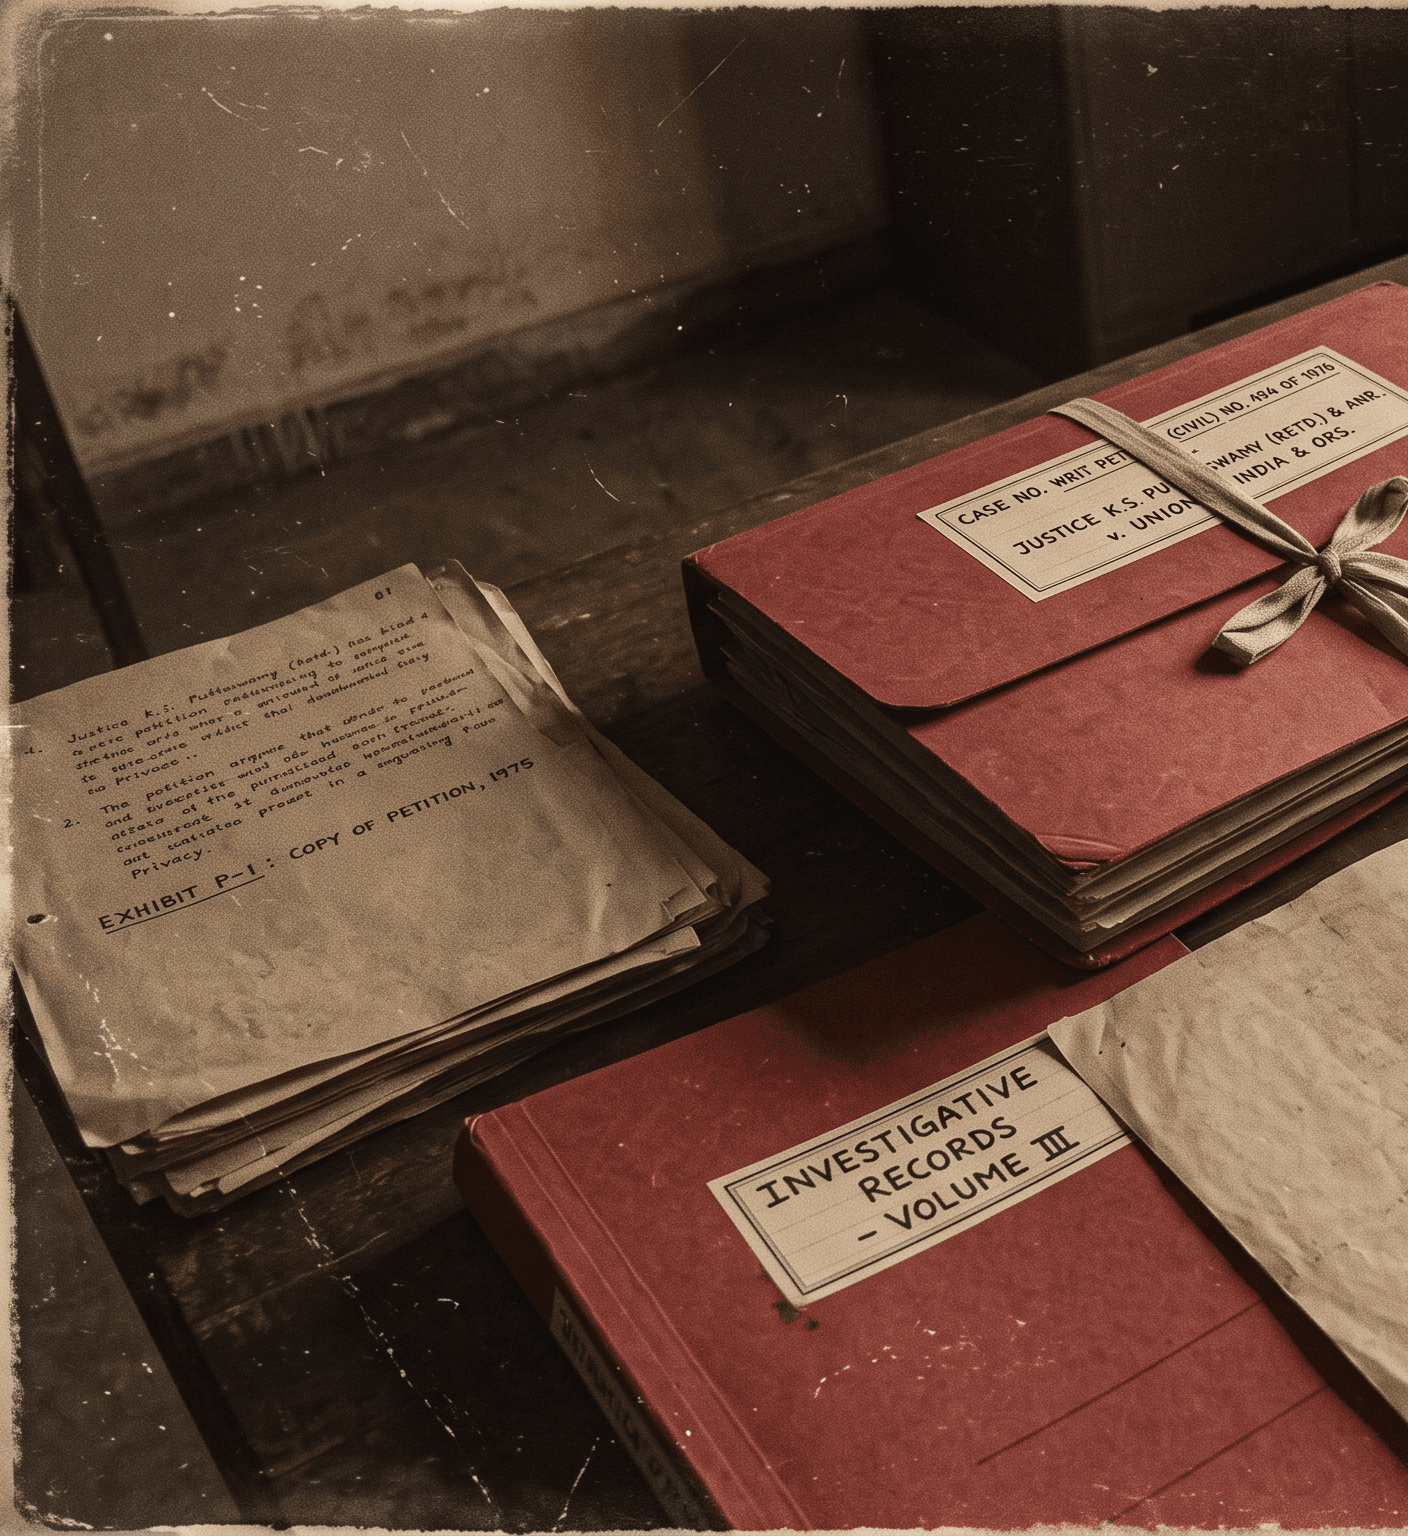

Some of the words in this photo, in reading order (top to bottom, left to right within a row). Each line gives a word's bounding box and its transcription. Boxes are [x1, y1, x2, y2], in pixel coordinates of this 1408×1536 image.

[957, 498, 1011, 525] CASE
[1011, 486, 1048, 503] NO.
[1048, 464, 1092, 487] WRIT
[1166, 411, 1220, 440] (CIVIL)
[1218, 400, 1250, 415] NO.
[1279, 375, 1298, 389] OF
[1012, 512, 1101, 555] JUSTICE
[1102, 496, 1144, 517] K.S.
[1264, 411, 1328, 445] (RETD.)
[1326, 406, 1345, 417] &
[1345, 390, 1386, 410] ANR.
[1128, 495, 1199, 530] UNION
[1232, 455, 1290, 484] INDIA
[1290, 446, 1310, 458] &
[1311, 426, 1355, 448] ORS.
[63, 817, 80, 829] 2.
[99, 800, 130, 814] The
[97, 884, 197, 931] EXHIBIT
[214, 863, 256, 889] P-1
[288, 831, 339, 859] COPY
[351, 819, 374, 836] OF
[386, 780, 486, 823] PETITION,
[488, 756, 534, 782] 1975
[130, 848, 211, 880] Privacy.
[755, 1065, 1038, 1208] INVESTIGATIVE
[857, 1115, 1017, 1203] RECORDS
[883, 1152, 1030, 1230] VOLUME
[1029, 1124, 1080, 1162] III
